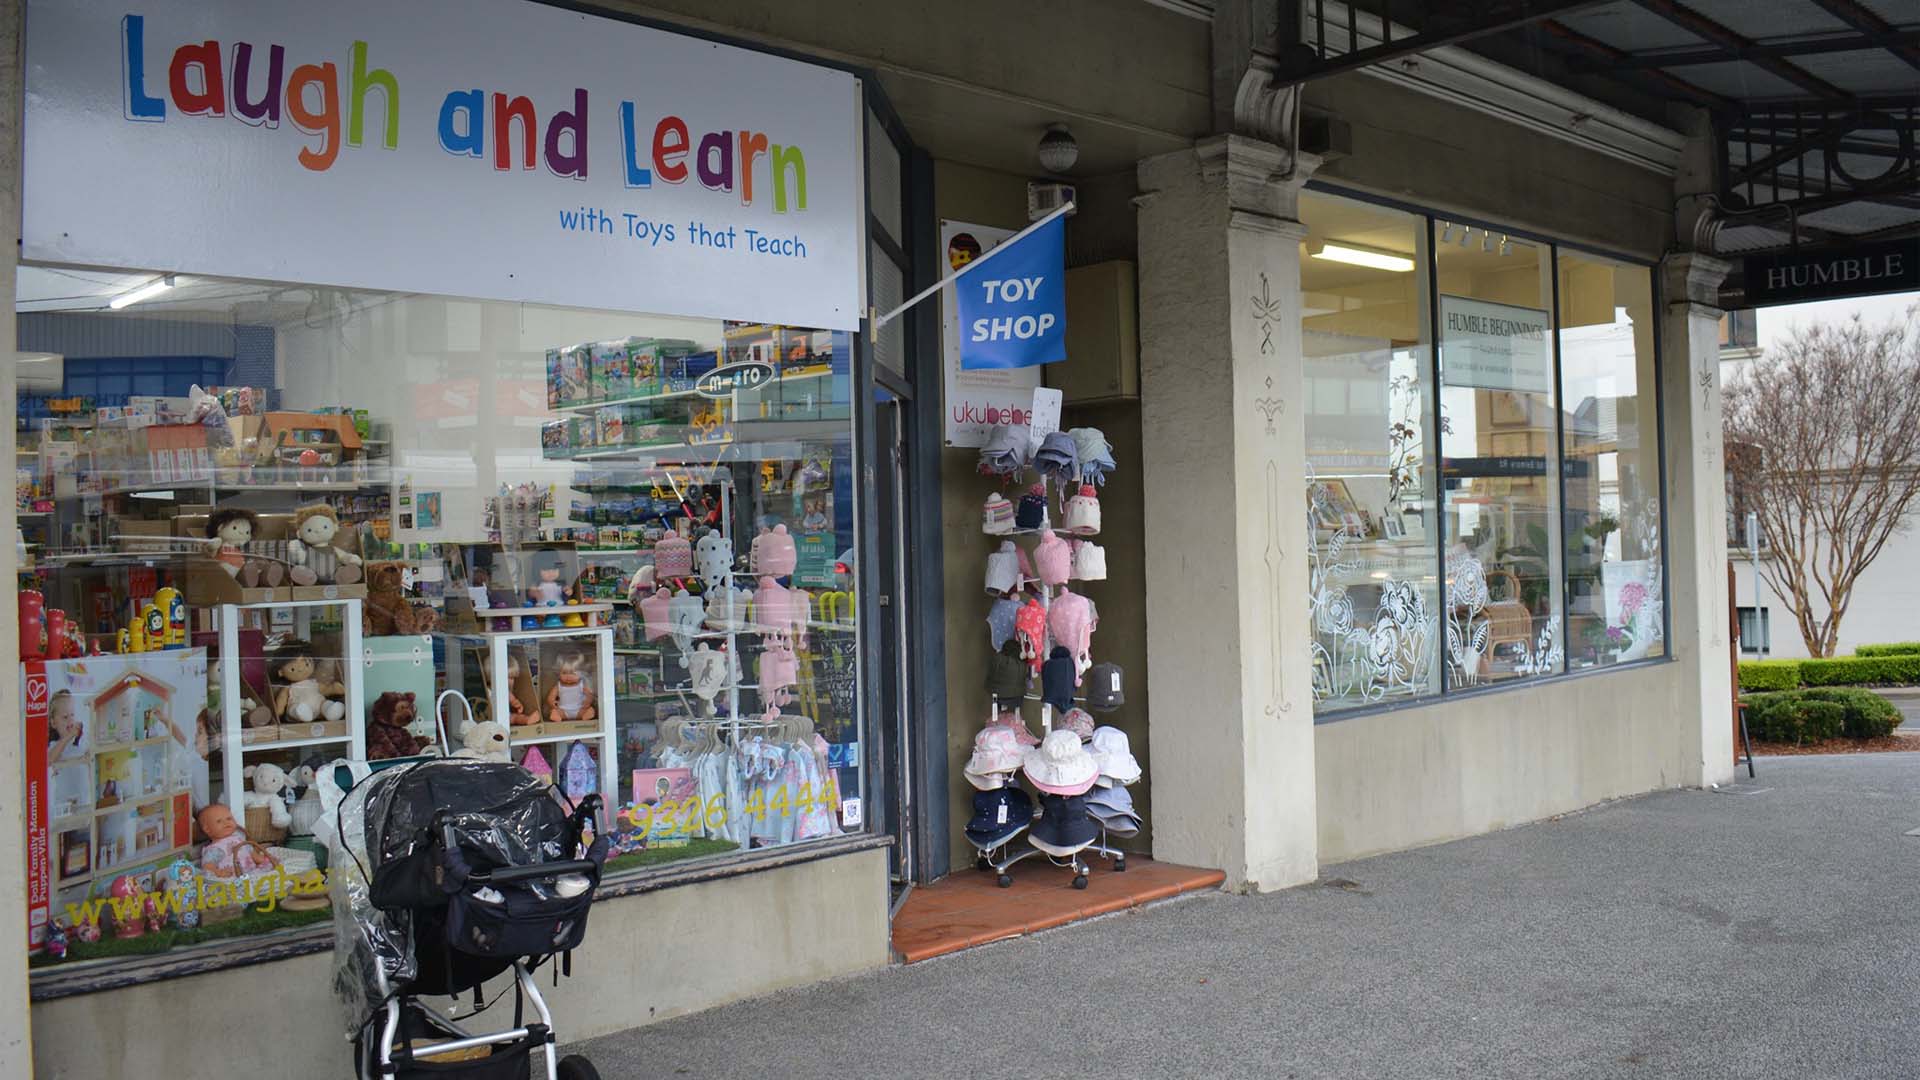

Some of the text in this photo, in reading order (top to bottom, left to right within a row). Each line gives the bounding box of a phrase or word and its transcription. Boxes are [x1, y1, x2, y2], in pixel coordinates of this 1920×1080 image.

[120, 14, 808, 214] Laugh and Learn
[559, 207, 807, 258] with Toys that Teach
[982, 276, 1044, 304] TOY
[1767, 253, 1905, 290] HUMBLE
[971, 313, 1056, 343] SHOP
[1447, 312, 1489, 335] HUMBLE
[629, 792, 728, 840] 9326
[744, 778, 837, 822] 4444
[30, 780, 39, 904] Doll Family Mansion
